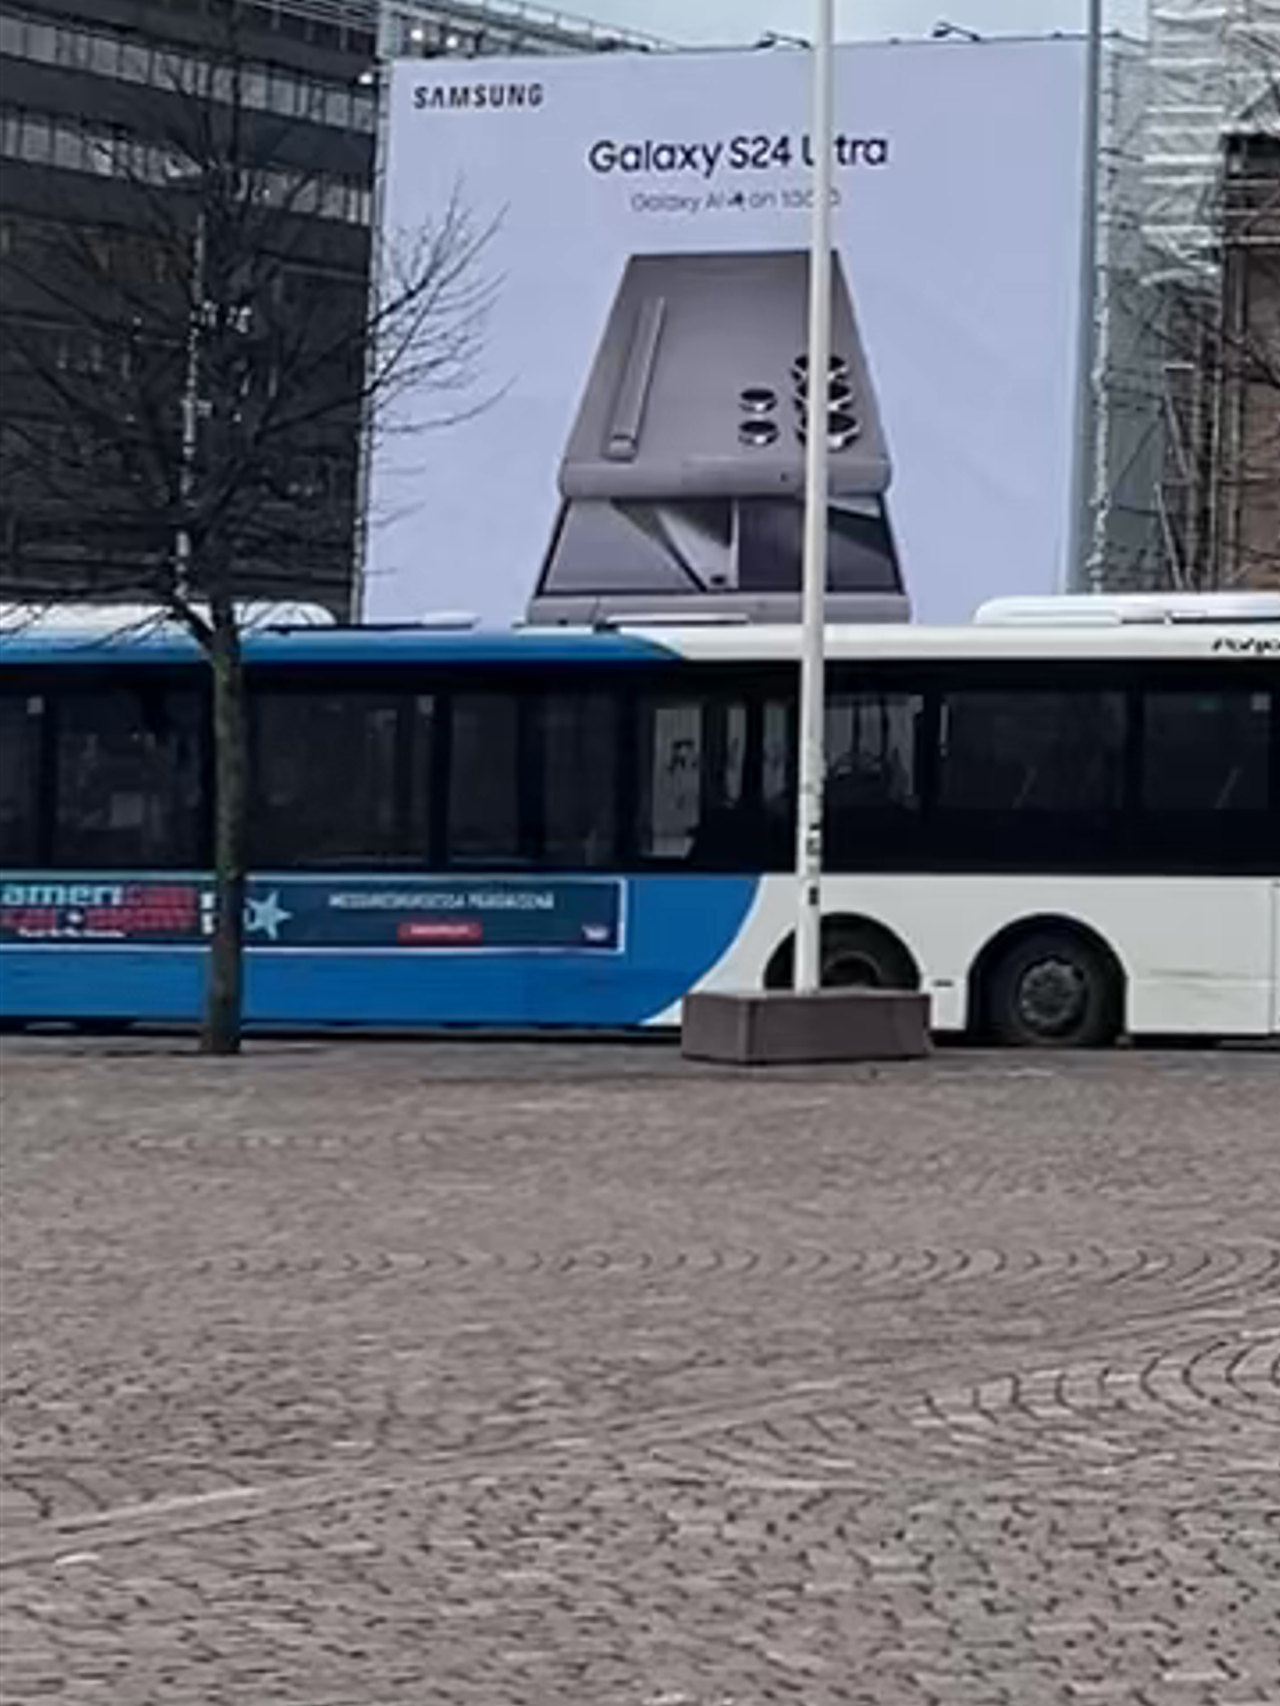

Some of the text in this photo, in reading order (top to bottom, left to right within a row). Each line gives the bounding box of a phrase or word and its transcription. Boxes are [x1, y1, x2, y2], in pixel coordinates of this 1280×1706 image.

[413, 83, 544, 110] SAMSUNG
[588, 133, 889, 180] Galaxy S24 Utra
[630, 191, 702, 214] Galaxy
